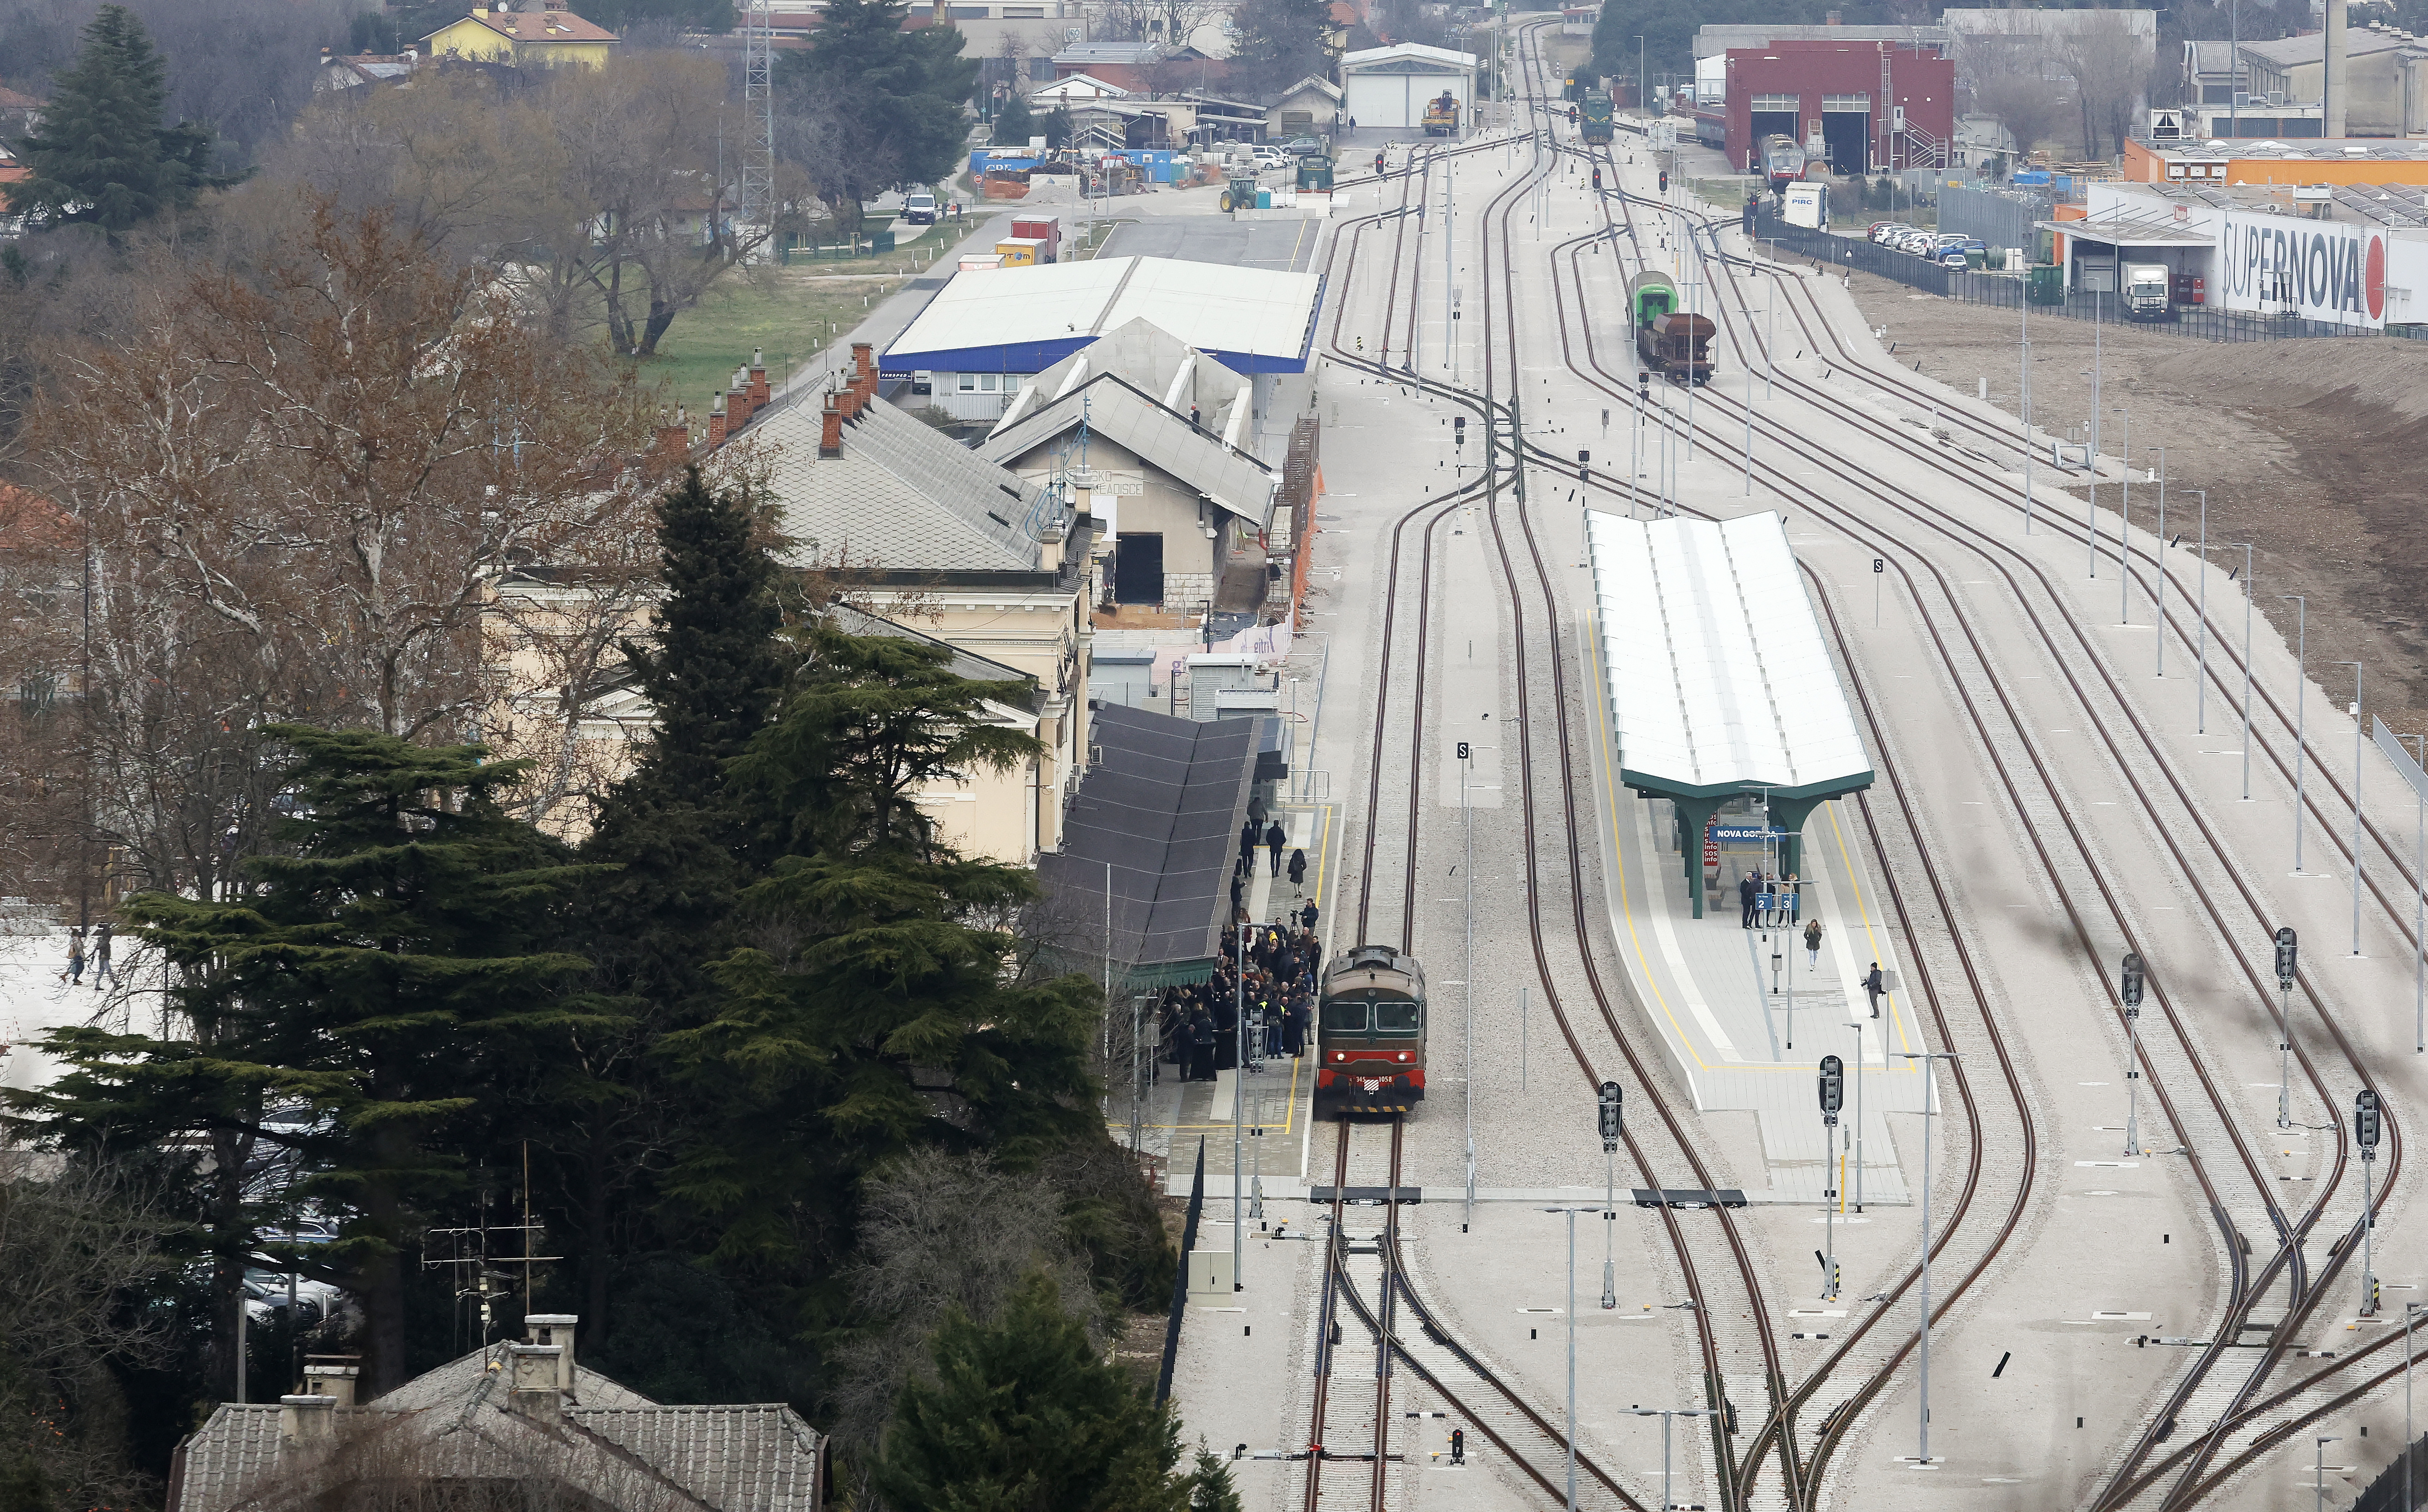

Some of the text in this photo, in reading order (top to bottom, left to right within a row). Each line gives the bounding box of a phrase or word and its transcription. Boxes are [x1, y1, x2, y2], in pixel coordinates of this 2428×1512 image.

[2223, 221, 2360, 313] SUPERNOVA
[1604, 411, 1608, 419] K
[1875, 561, 1882, 571] S
[1459, 744, 1467, 757] S
[1758, 900, 1765, 908] 2
[1783, 900, 1790, 909] 3
